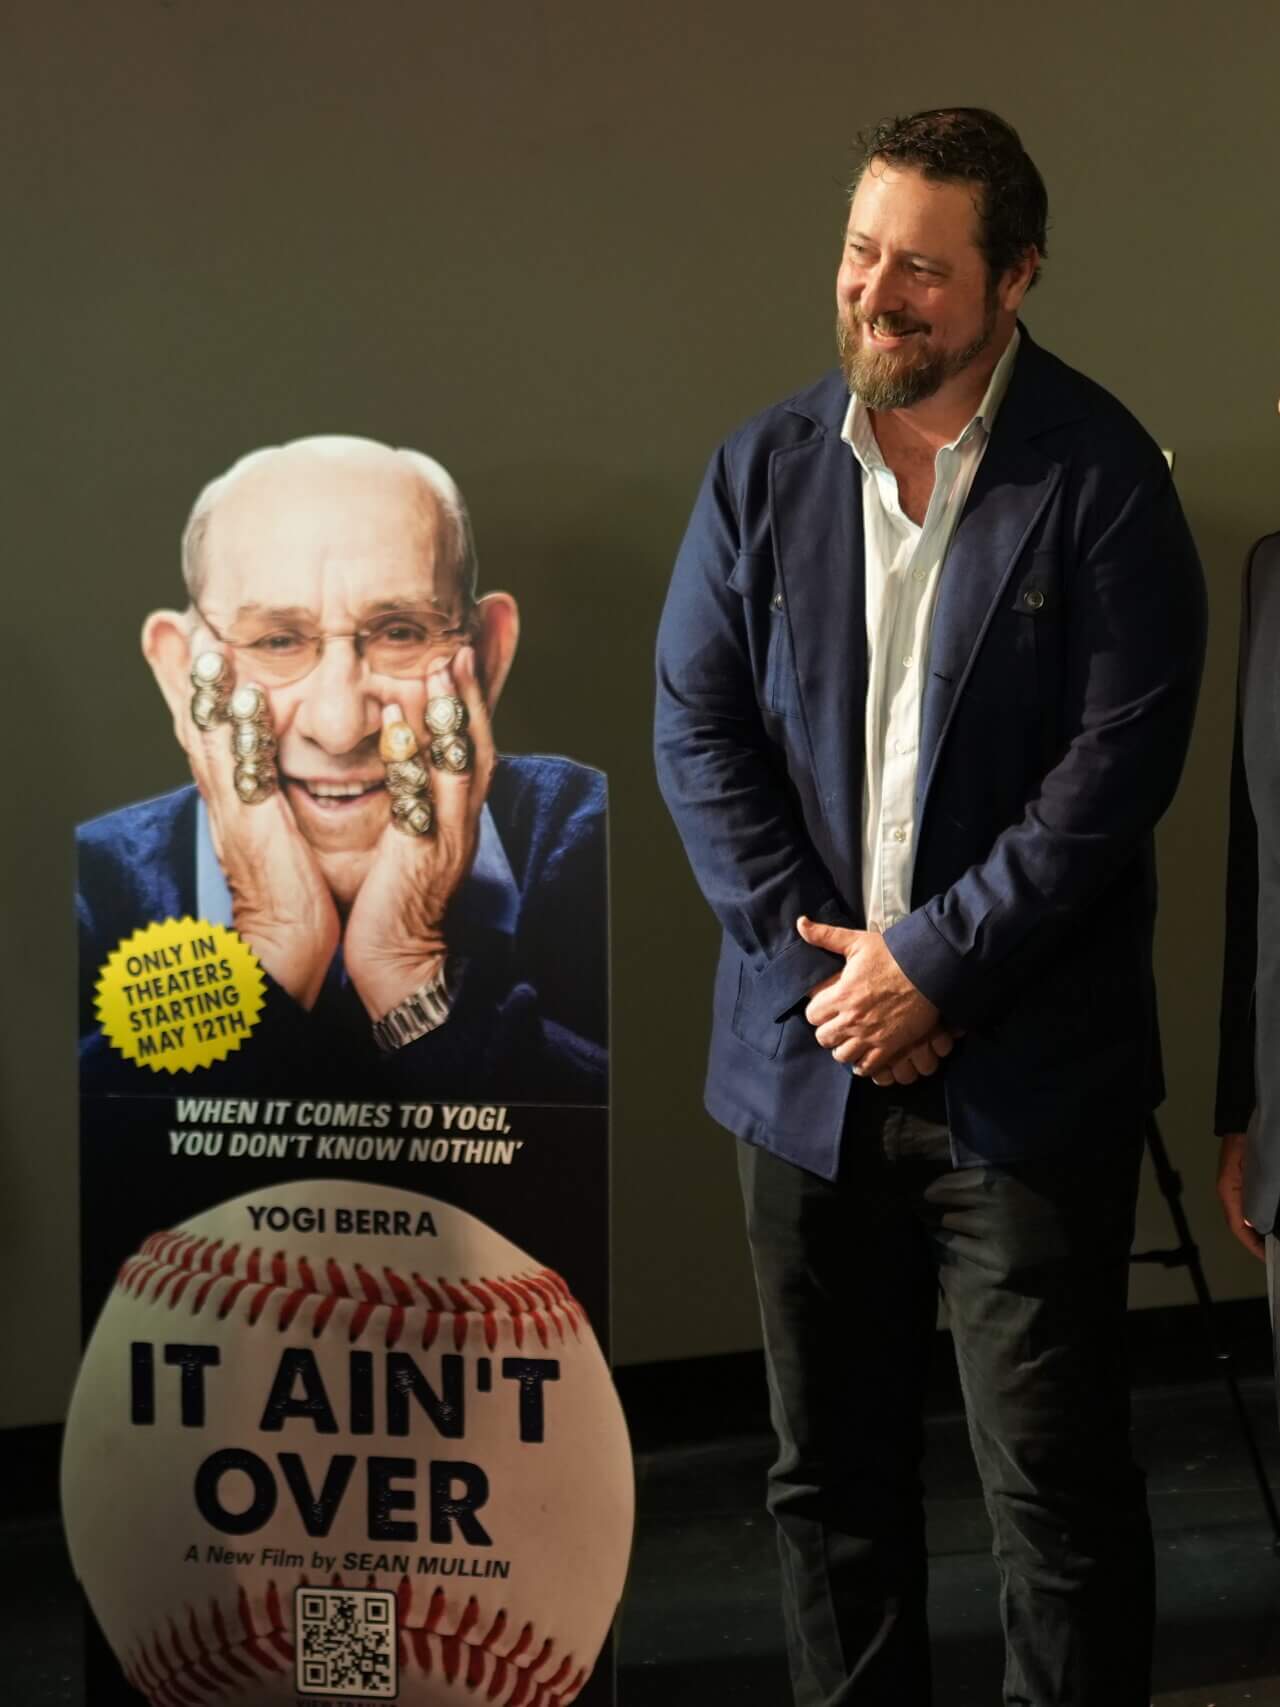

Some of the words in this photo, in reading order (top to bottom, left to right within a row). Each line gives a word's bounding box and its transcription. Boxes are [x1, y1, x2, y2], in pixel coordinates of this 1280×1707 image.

[126, 944, 182, 976] ONLY
[191, 936, 217, 960] IN
[123, 959, 232, 1006] THEATERS
[129, 985, 240, 1032] STARTING
[138, 1026, 185, 1058] MAY
[193, 1010, 246, 1043] 12TH
[175, 1097, 259, 1125] WHEN
[264, 1100, 291, 1125] IT
[296, 1102, 392, 1128] COMES
[399, 1105, 434, 1129] TO
[441, 1105, 512, 1134] YOGI,
[169, 1131, 224, 1156] YOU
[228, 1132, 313, 1159] DON'T
[316, 1136, 404, 1161] KNOW
[408, 1137, 524, 1165] NOTHIN'
[247, 1205, 326, 1233] YOGI
[335, 1208, 438, 1237] BERRA
[130, 1341, 220, 1428] IT
[258, 1347, 561, 1444] AIN'T
[193, 1447, 494, 1547] OVER
[184, 1544, 199, 1563] A
[206, 1545, 255, 1566] New
[260, 1548, 305, 1568] Film
[311, 1551, 337, 1574] by
[343, 1552, 410, 1574] SEAN
[416, 1556, 512, 1579] MULLIN
